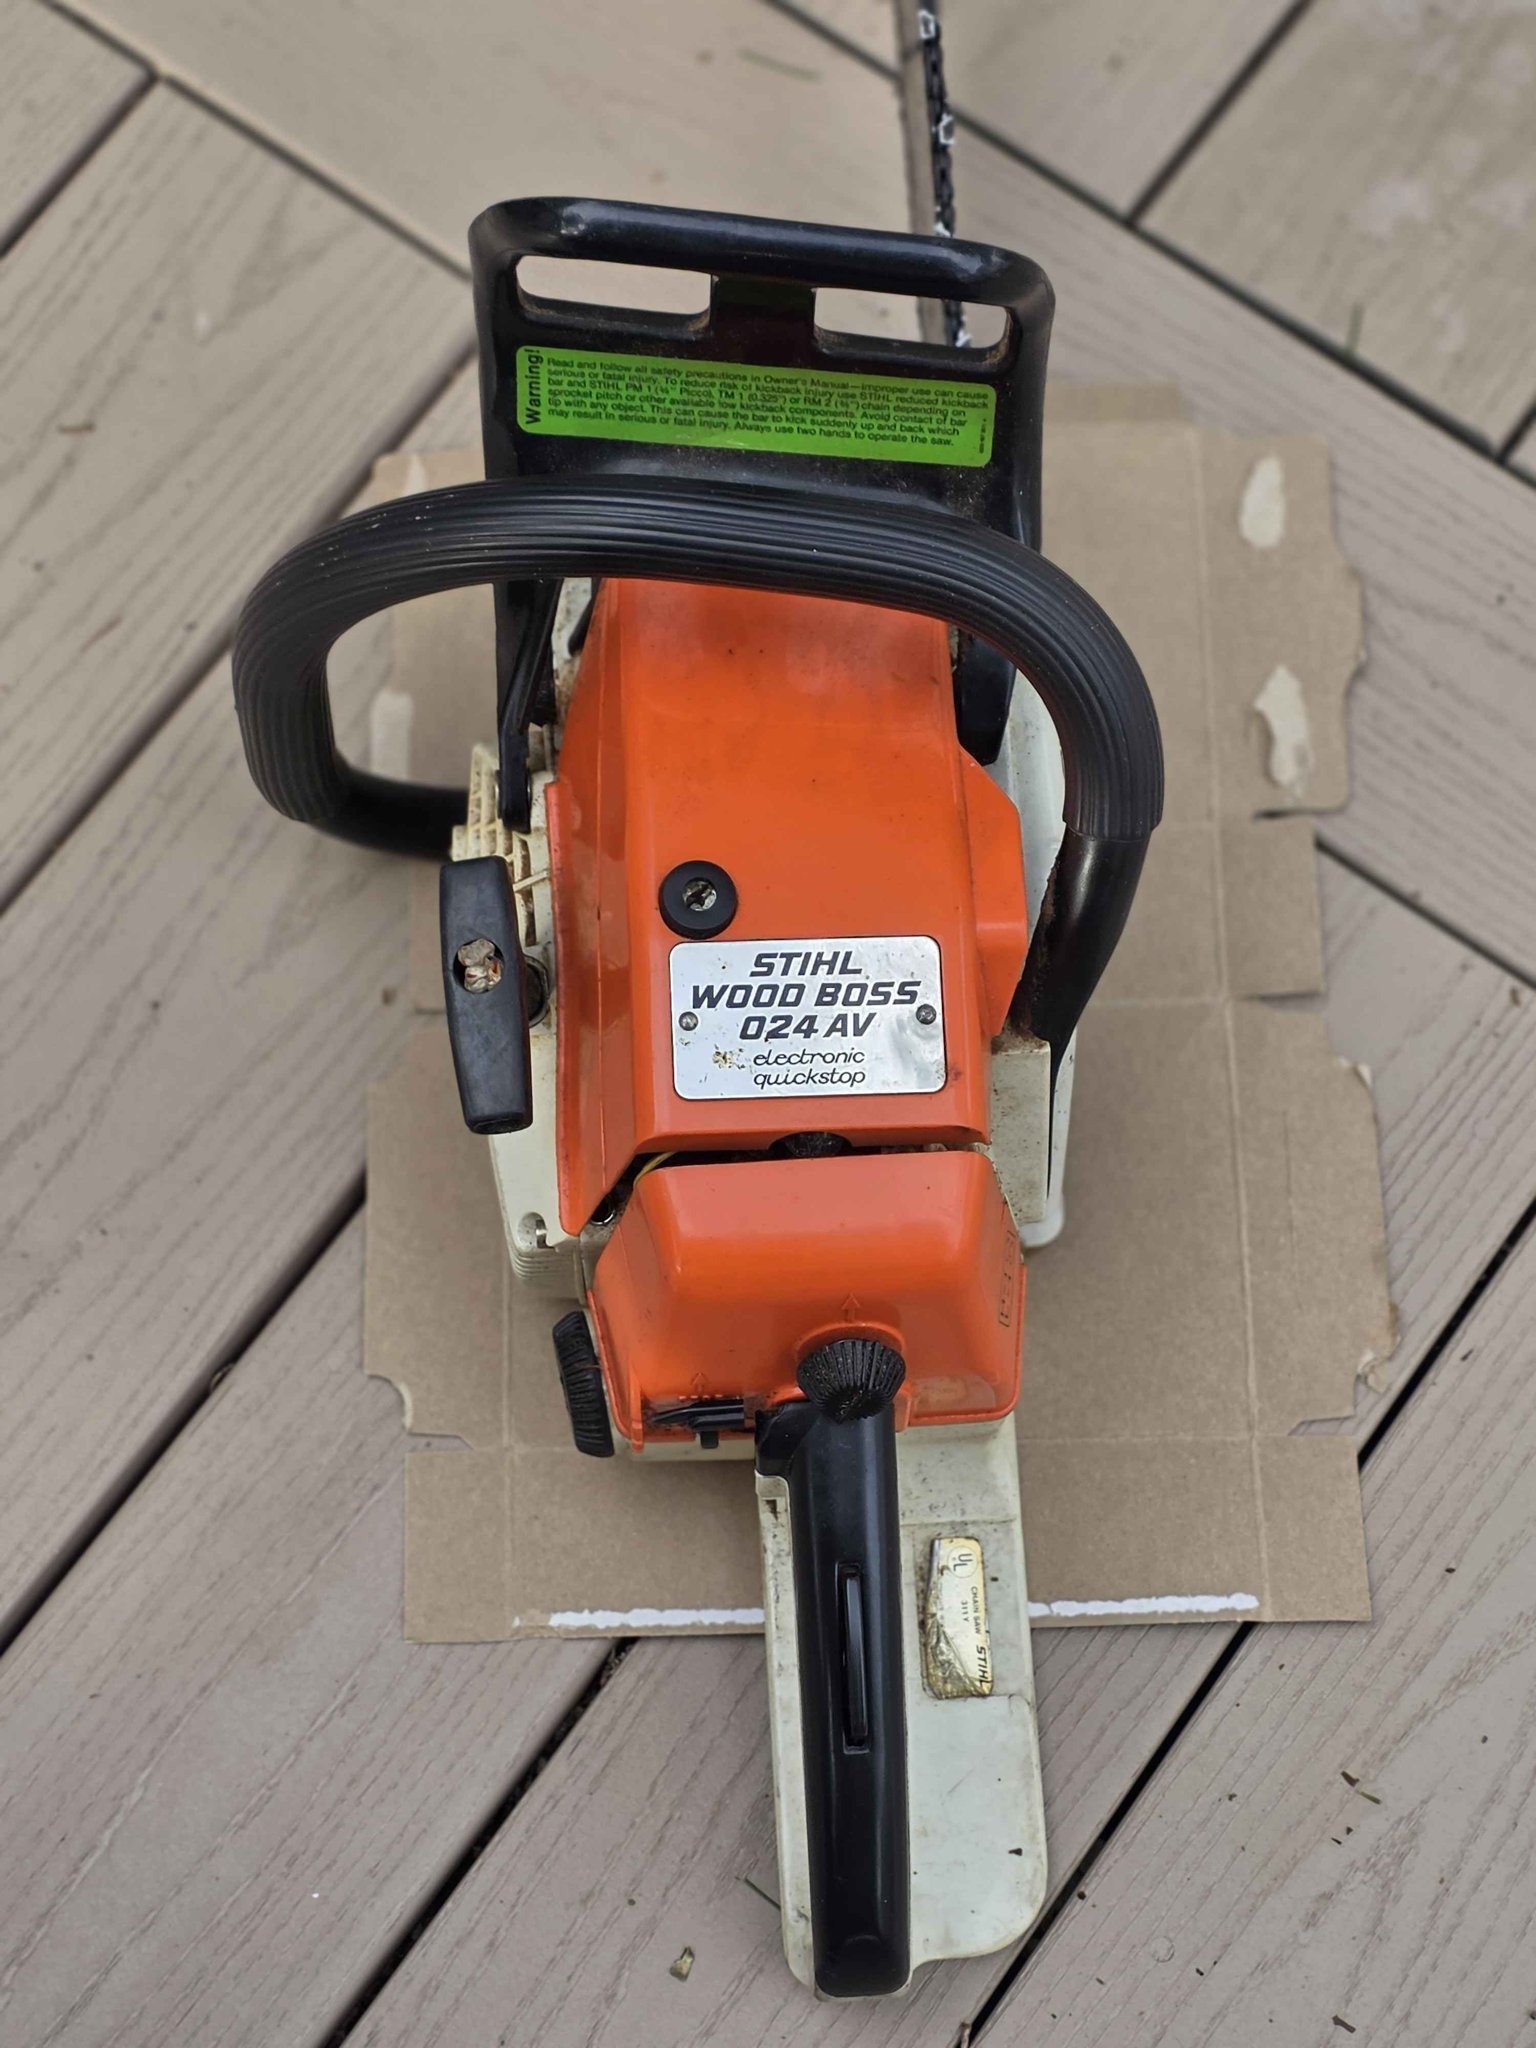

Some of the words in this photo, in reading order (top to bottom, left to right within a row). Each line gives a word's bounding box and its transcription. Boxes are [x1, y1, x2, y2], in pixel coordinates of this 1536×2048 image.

[525, 349, 543, 425] Warning!
[547, 358, 573, 367] Read
[576, 360, 595, 369] and
[599, 361, 631, 371] follow
[634, 364, 647, 373] all
[650, 365, 681, 377] safety
[685, 368, 747, 382] precautions
[763, 374, 807, 385] Owner's
[955, 391, 988, 399] cause
[547, 367, 585, 377] serious
[602, 371, 625, 380] fatal
[664, 376, 677, 384] To
[679, 377, 716, 387] reduce
[719, 380, 738, 389] risk
[755, 383, 801, 394] kickback
[804, 387, 834, 398] injury
[859, 391, 891, 401] STIHL
[895, 393, 938, 404] reduced
[941, 397, 988, 408] kickback
[547, 377, 563, 386] bar
[566, 378, 586, 387] and
[588, 380, 622, 390] STIHL
[625, 382, 642, 392] PM
[719, 390, 735, 399] TM
[861, 400, 890, 411] chain
[893, 403, 948, 417] depending
[547, 387, 592, 399] sprocket
[595, 391, 622, 402] pitch
[639, 394, 666, 403] other
[669, 396, 715, 407] available
[718, 400, 736, 408] low
[739, 402, 785, 412] kickback
[788, 405, 855, 419] components.
[860, 411, 890, 420] Avoid
[892, 413, 932, 423] contact
[949, 418, 967, 426] bar
[547, 397, 561, 407] tip
[563, 398, 587, 408] with
[589, 402, 608, 411] any
[611, 401, 646, 414] object.
[650, 404, 672, 414] This
[675, 408, 694, 416] can
[697, 410, 729, 418] cause
[731, 411, 749, 420] the
[751, 412, 769, 421] bar
[784, 415, 806, 424] kick
[809, 416, 856, 430] suddenly
[860, 422, 874, 431] up
[876, 422, 896, 431] and
[899, 423, 924, 433] back
[927, 425, 959, 436] which
[547, 409, 569, 418] may
[572, 409, 601, 419] result
[618, 412, 657, 423] serious
[673, 417, 696, 426] fatal
[734, 421, 772, 434] Always
[774, 426, 794, 434] use
[796, 426, 816, 435] two
[819, 428, 851, 438] hands
[867, 431, 908, 444] operate
[910, 435, 928, 444] the
[930, 438, 954, 446] saw.
[750, 951, 862, 977] STIHL
[692, 984, 806, 1008] WOOD
[814, 981, 921, 1007] BOSS
[739, 1014, 819, 1040] 024
[824, 1012, 877, 1038] AV
[753, 1047, 866, 1066] electronic
[753, 1067, 866, 1090] quickstop
[971, 1586, 979, 1613] CHAIN
[973, 1615, 982, 1635] SAW
[976, 1645, 990, 1686] STIHL
